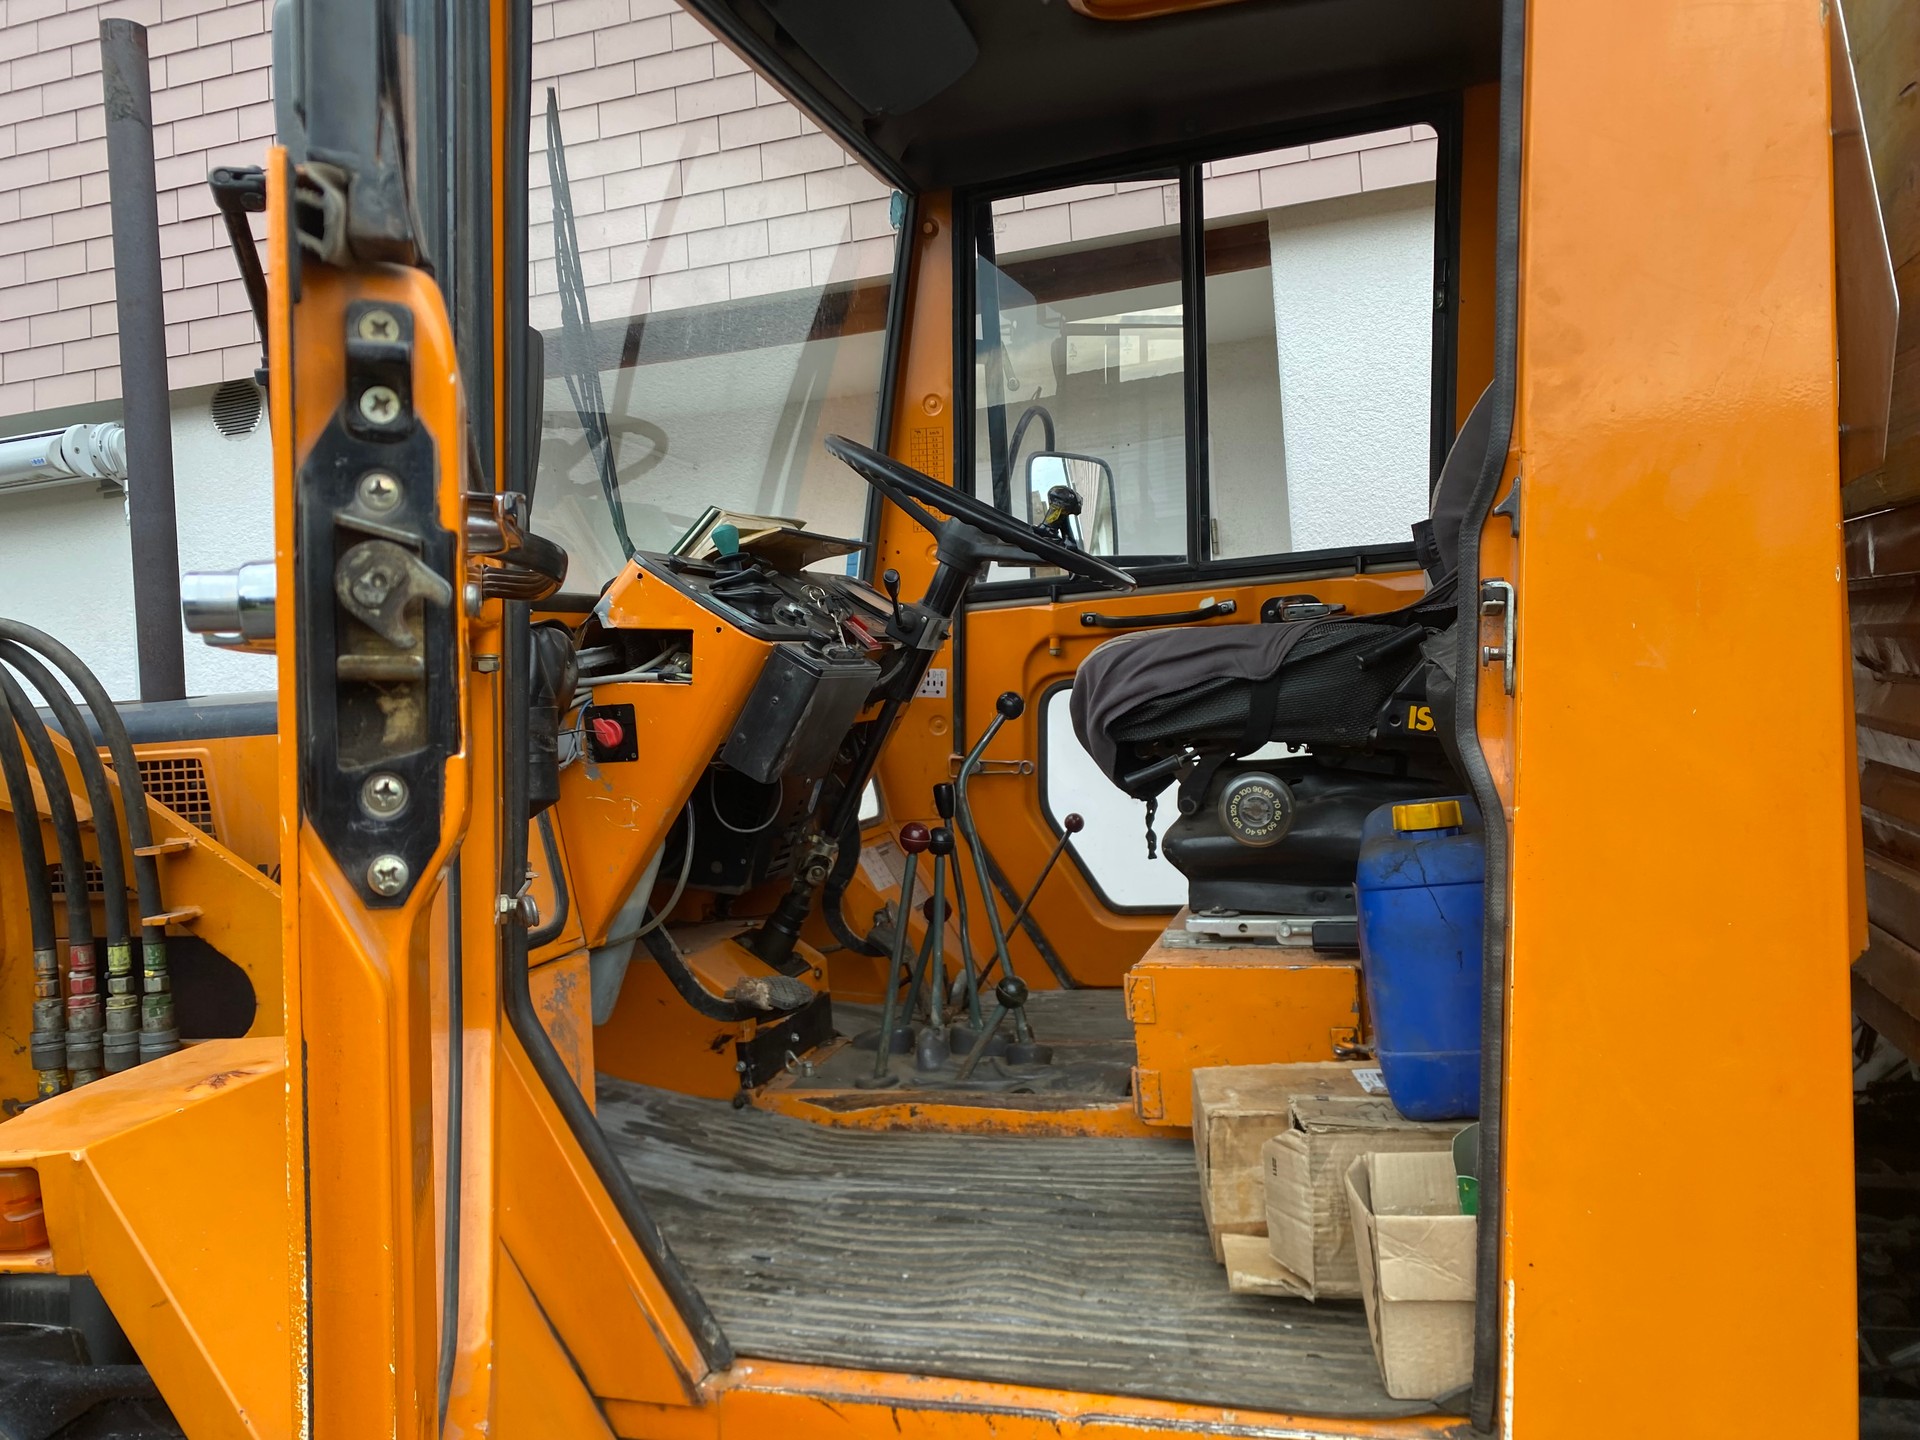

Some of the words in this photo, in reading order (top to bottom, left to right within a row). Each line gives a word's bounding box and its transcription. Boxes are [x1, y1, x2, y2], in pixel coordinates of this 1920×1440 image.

[1407, 705, 1437, 732] IS
[1239, 786, 1252, 796] 100
[1252, 785, 1263, 793] 90
[1263, 789, 1274, 799] 80
[1232, 794, 1241, 805] 110
[1273, 799, 1281, 809] 70
[1274, 810, 1282, 821] 60
[1232, 817, 1244, 829] 130
[1267, 821, 1278, 831] 50
